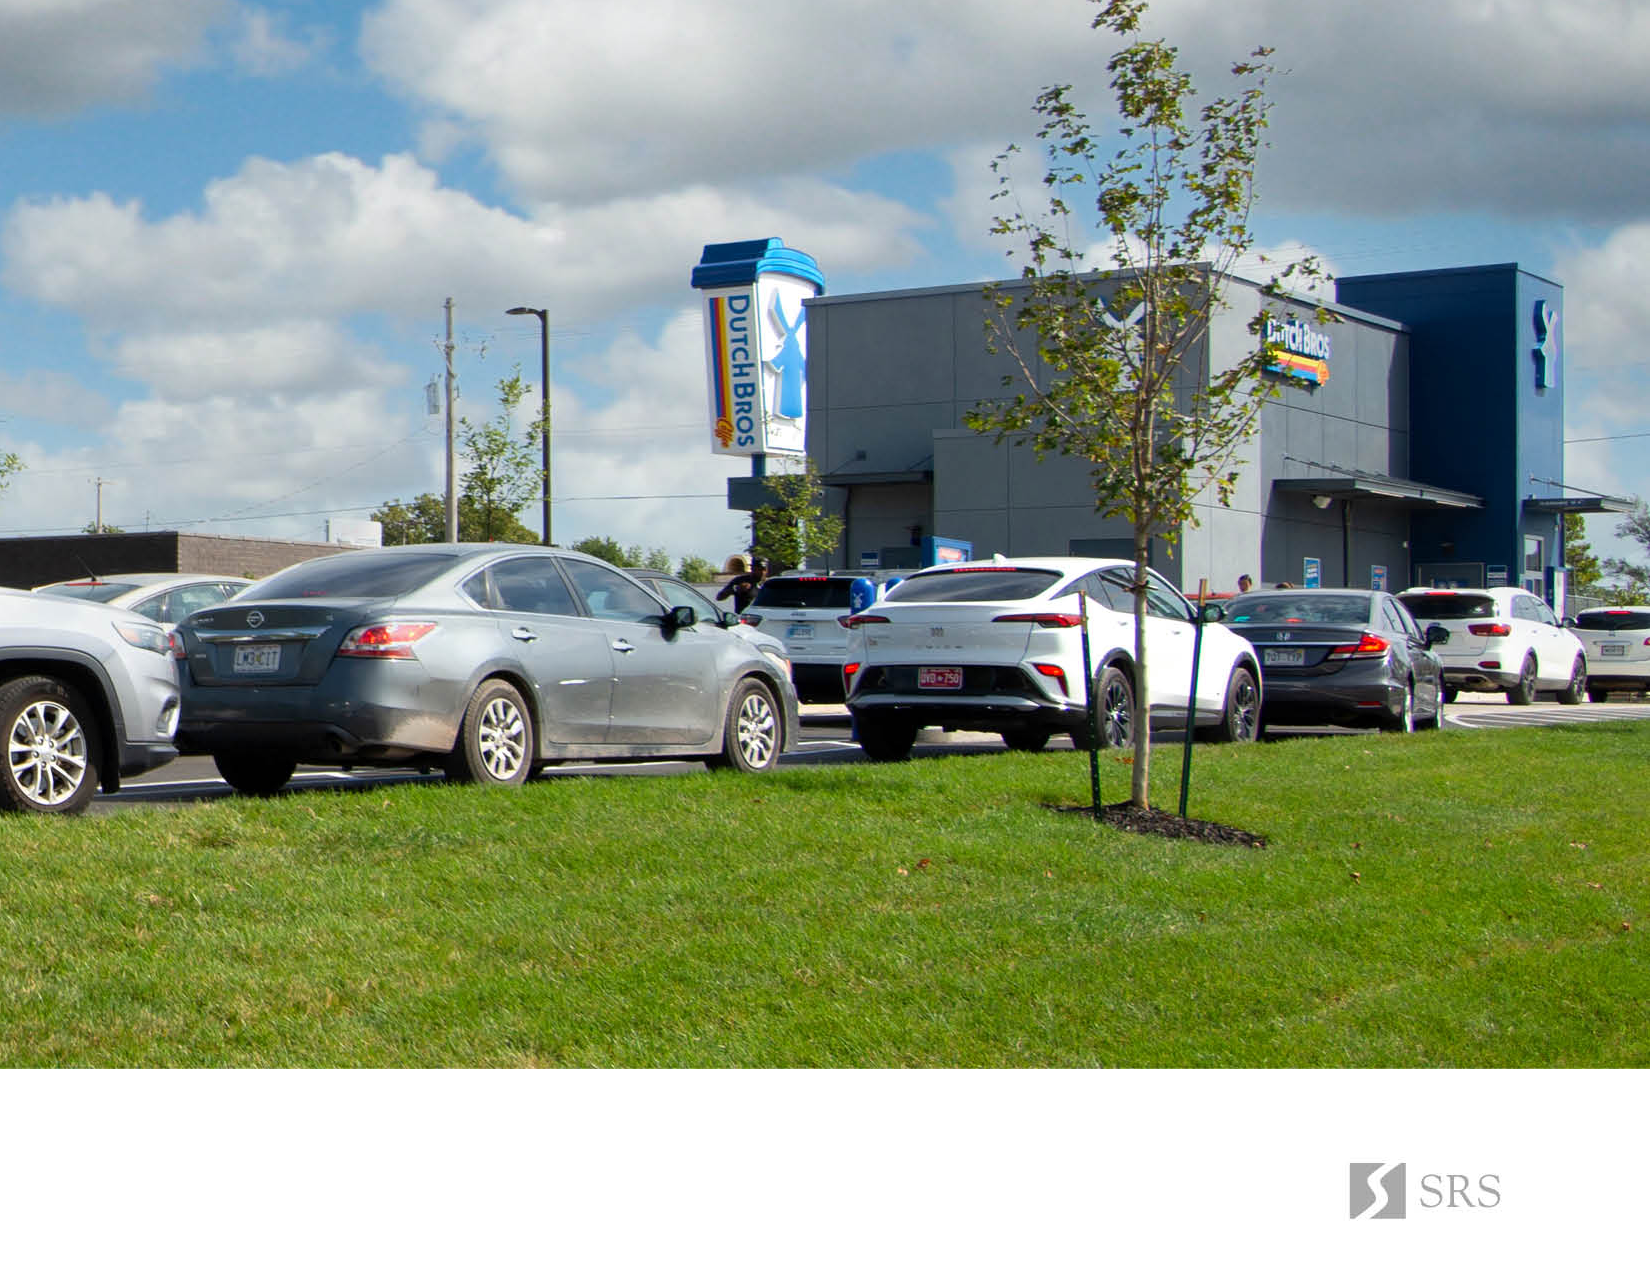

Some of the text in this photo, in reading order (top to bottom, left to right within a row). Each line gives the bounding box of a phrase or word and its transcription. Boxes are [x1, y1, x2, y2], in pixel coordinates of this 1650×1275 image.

[728, 295, 756, 447] DUTCH BROS
[1304, 323, 1330, 359] BROS
